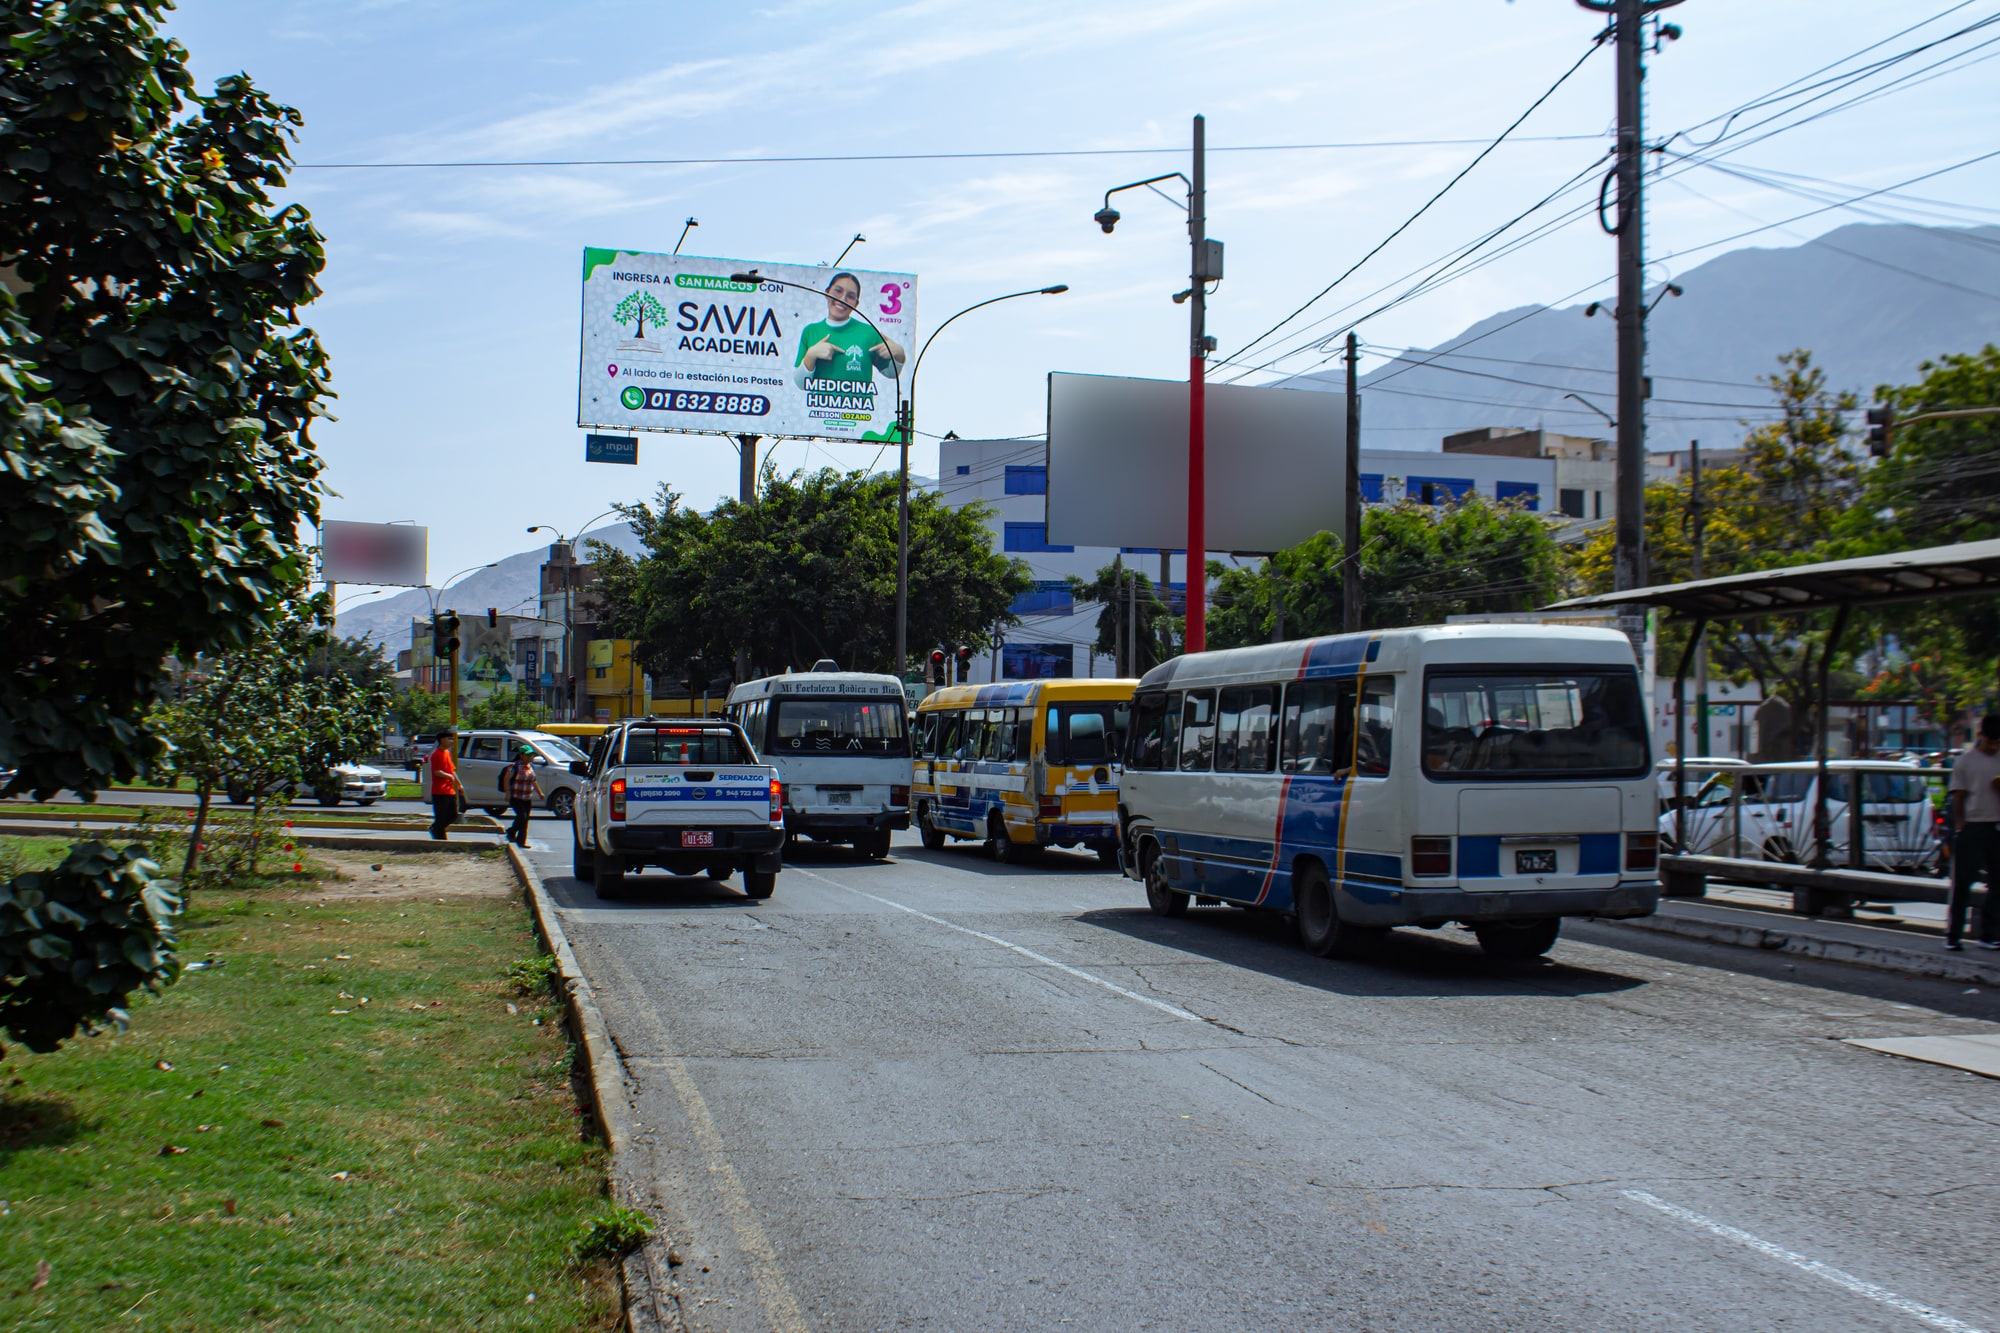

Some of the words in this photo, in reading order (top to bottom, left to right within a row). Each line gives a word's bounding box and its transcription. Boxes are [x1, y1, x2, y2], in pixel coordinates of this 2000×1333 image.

[613, 272, 661, 284] INGRESA
[663, 276, 671, 285] A
[679, 277, 701, 287] SAN
[704, 278, 753, 291] MARCOS
[759, 283, 784, 293] CON
[676, 301, 782, 338] SAVIA
[678, 335, 779, 357] ACADEMIA
[622, 368, 632, 377] Al
[634, 368, 657, 378] lado
[659, 370, 672, 379] de
[674, 371, 684, 380] la
[686, 372, 730, 383] estación
[732, 374, 749, 384] Los
[751, 375, 784, 387] Postes
[804, 378, 878, 395] MEDICINA
[651, 392, 672, 408] 01
[675, 393, 710, 411] 632
[714, 395, 765, 414] 8888
[807, 394, 874, 410] HUMANA
[809, 410, 840, 419] ALISSON
[841, 412, 872, 421] LOZANO
